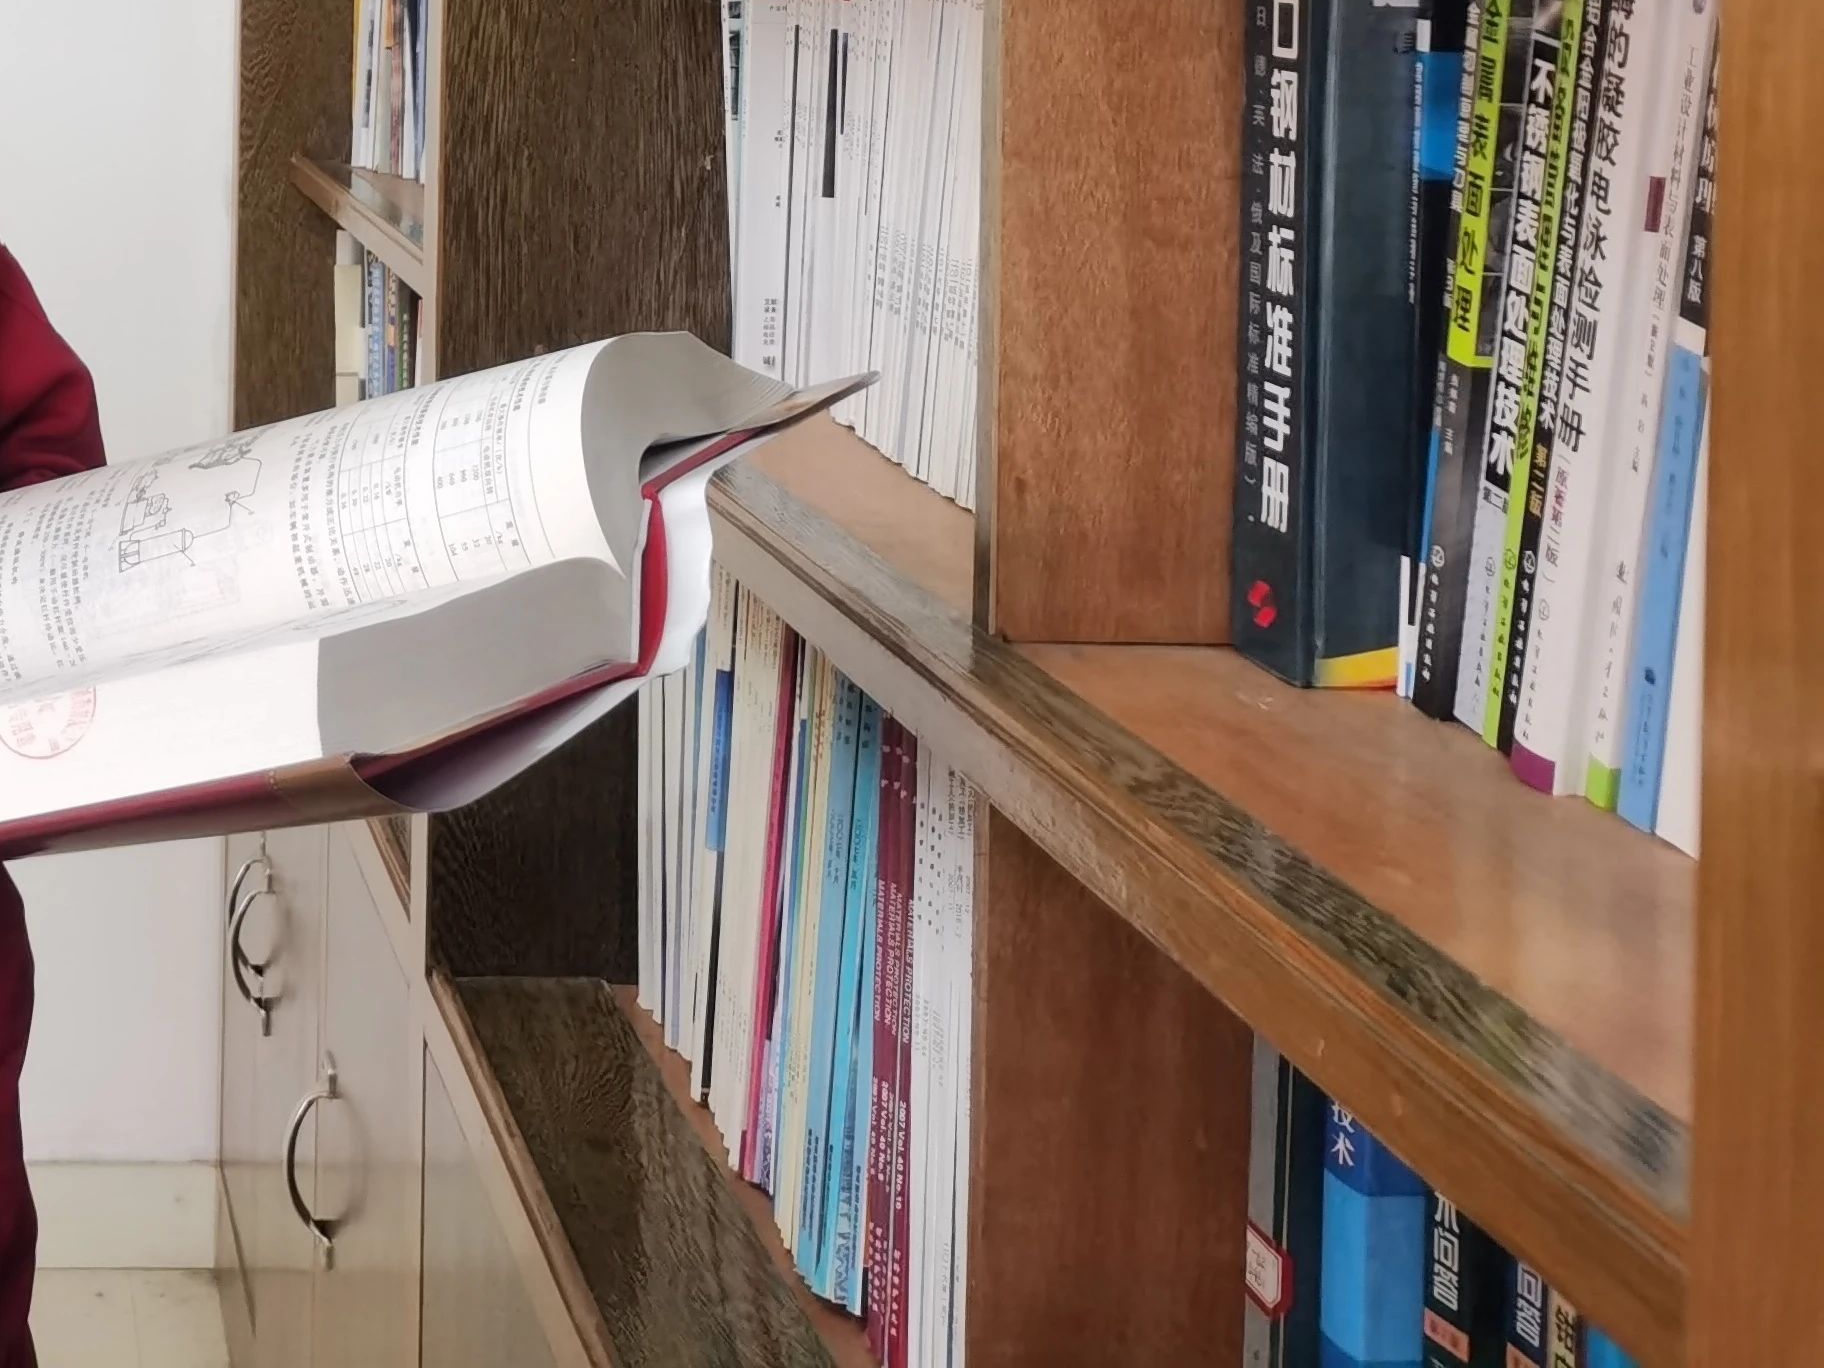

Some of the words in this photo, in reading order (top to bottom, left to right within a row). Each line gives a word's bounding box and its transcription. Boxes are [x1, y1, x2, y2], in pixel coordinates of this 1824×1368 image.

[1489, 57, 1558, 476] 不锈钢表面处理技术
[898, 1100, 907, 1129] 2007
